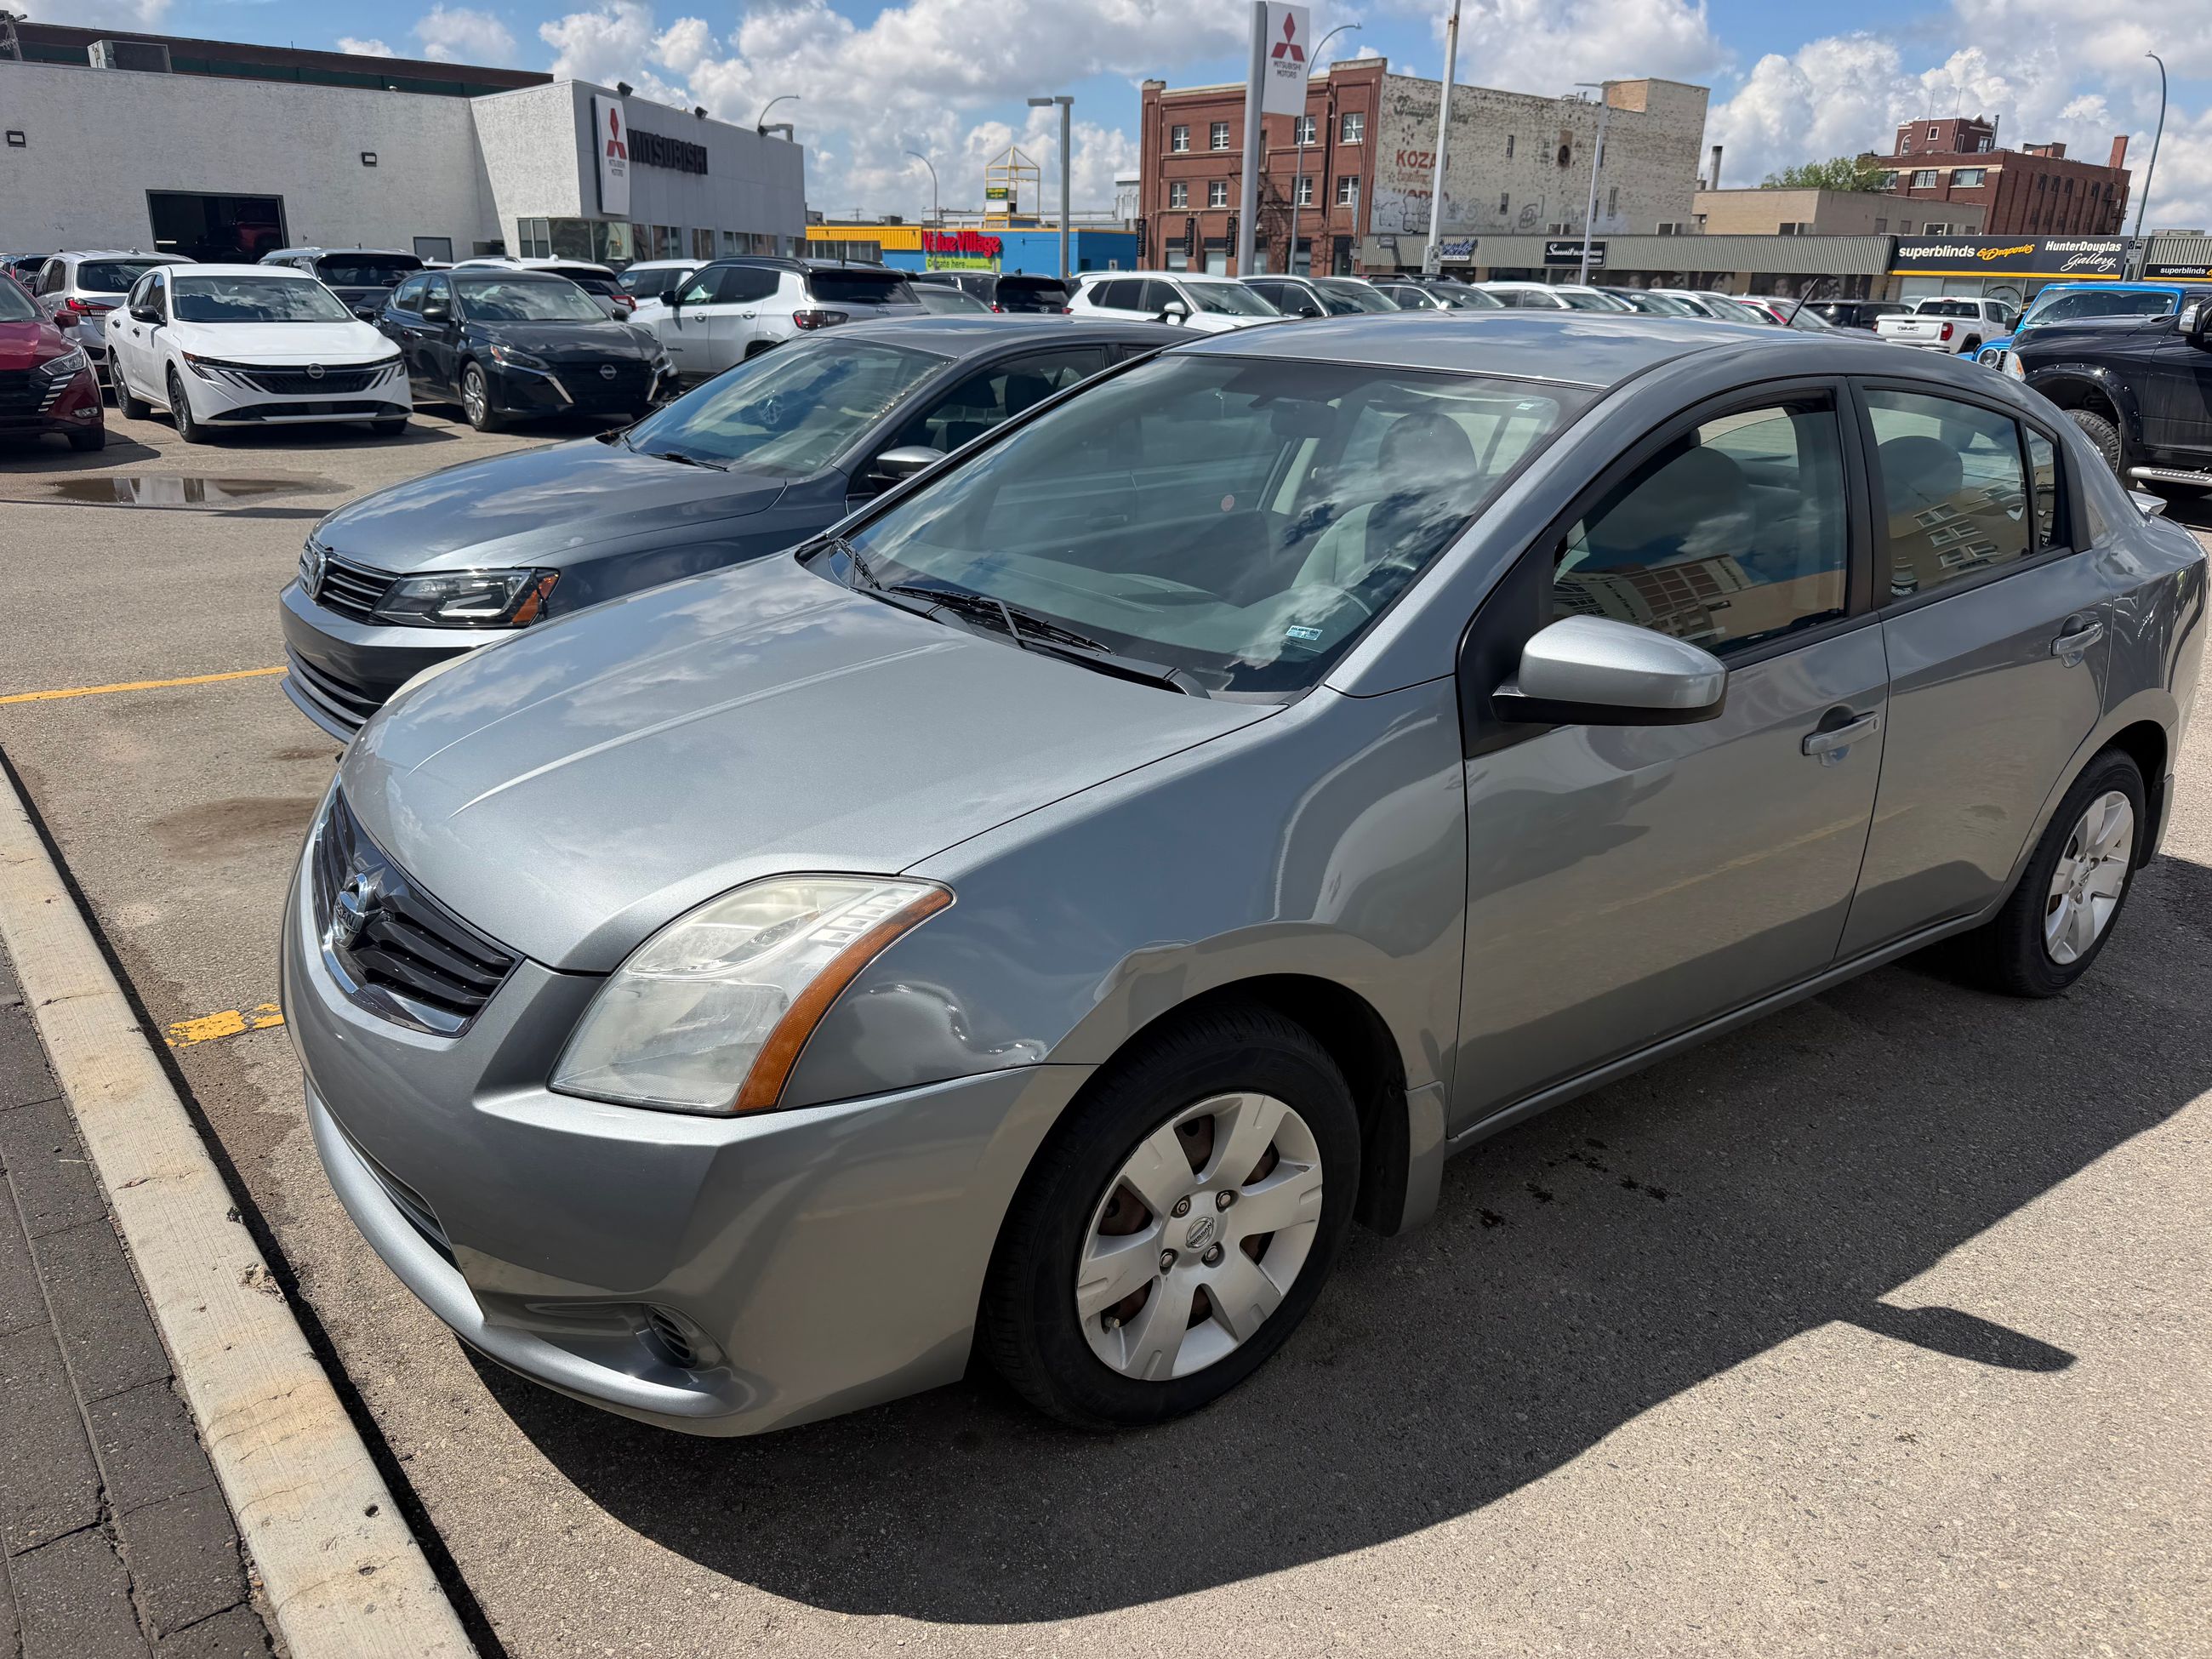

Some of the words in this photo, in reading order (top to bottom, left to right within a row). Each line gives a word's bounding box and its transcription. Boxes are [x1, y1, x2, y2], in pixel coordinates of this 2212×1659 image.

[1274, 60, 1301, 71] MITSUBISHI
[1277, 70, 1297, 78] MOTORS
[626, 128, 708, 175] MITSUBISHI
[957, 231, 1001, 258] Village
[1899, 245, 1975, 259] superblinds
[2060, 253, 2117, 272] Gallery
[2160, 266, 2206, 275] superblinds
[1191, 1222, 1212, 1245] NISSAN
